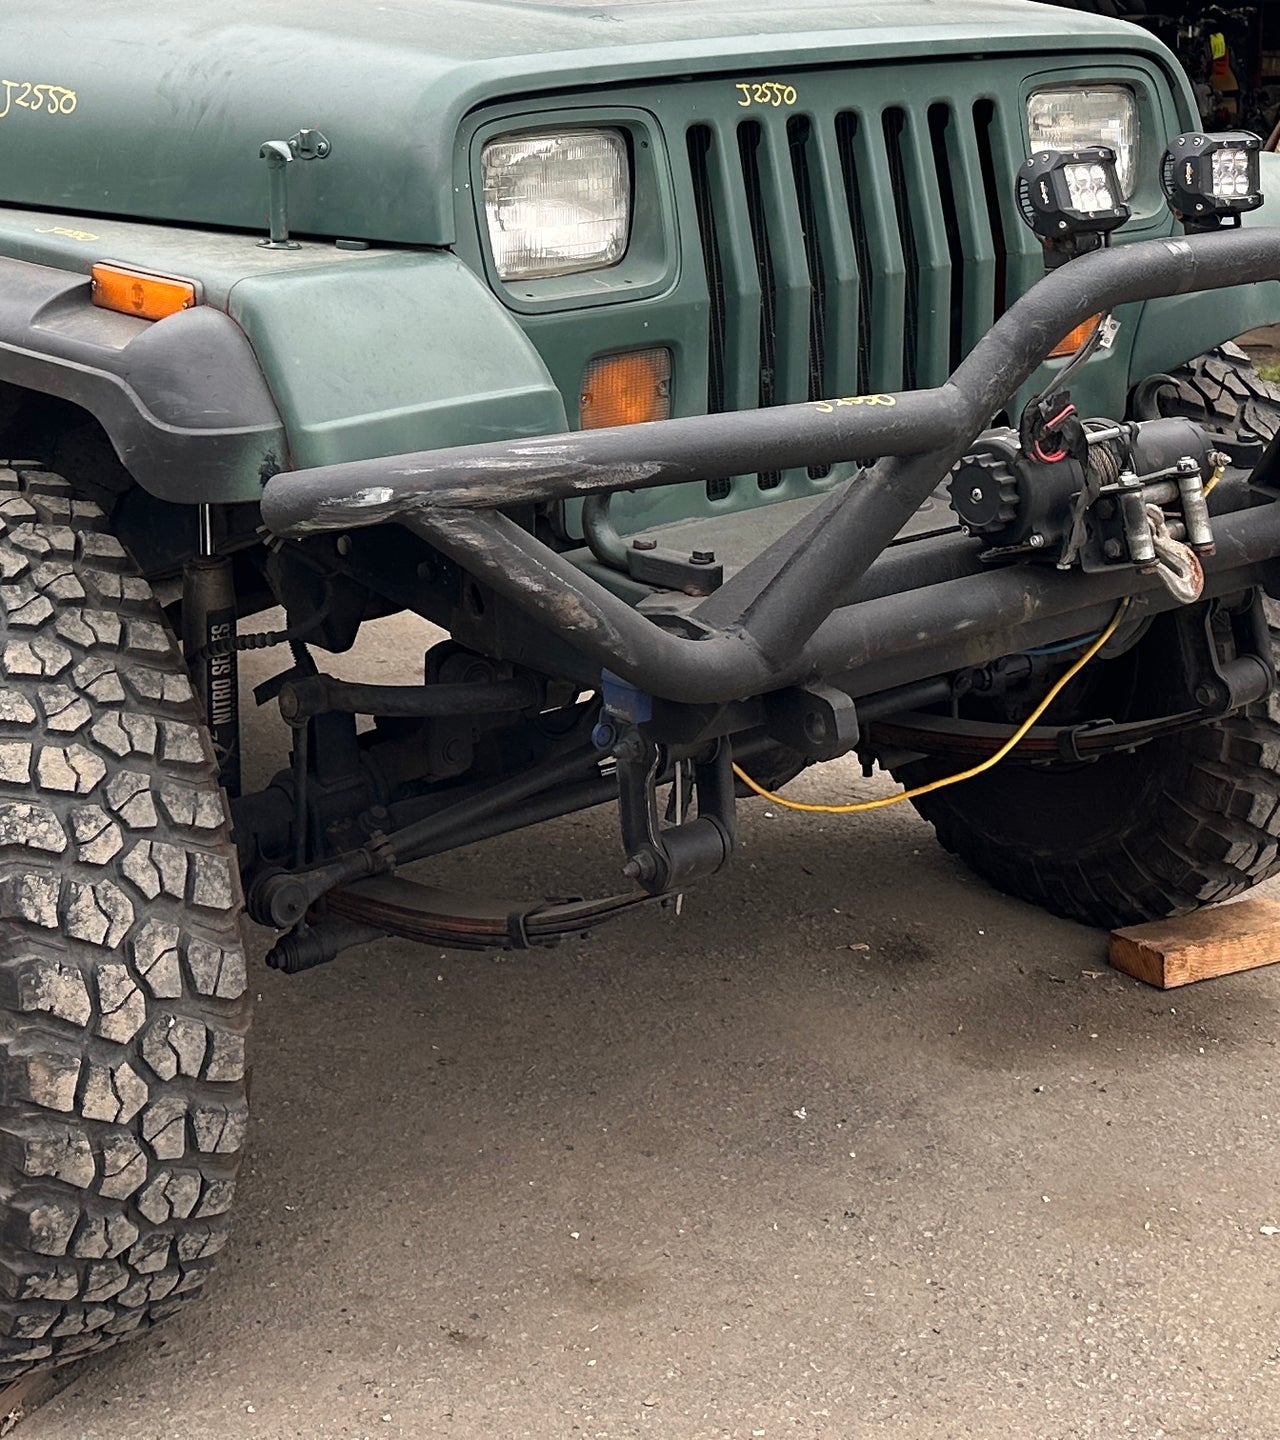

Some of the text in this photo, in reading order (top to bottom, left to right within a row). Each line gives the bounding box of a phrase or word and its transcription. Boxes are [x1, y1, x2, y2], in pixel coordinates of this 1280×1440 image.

[735, 82, 797, 107] J2550
[211, 622, 232, 676] SEES
[212, 677, 233, 725] NITRO
